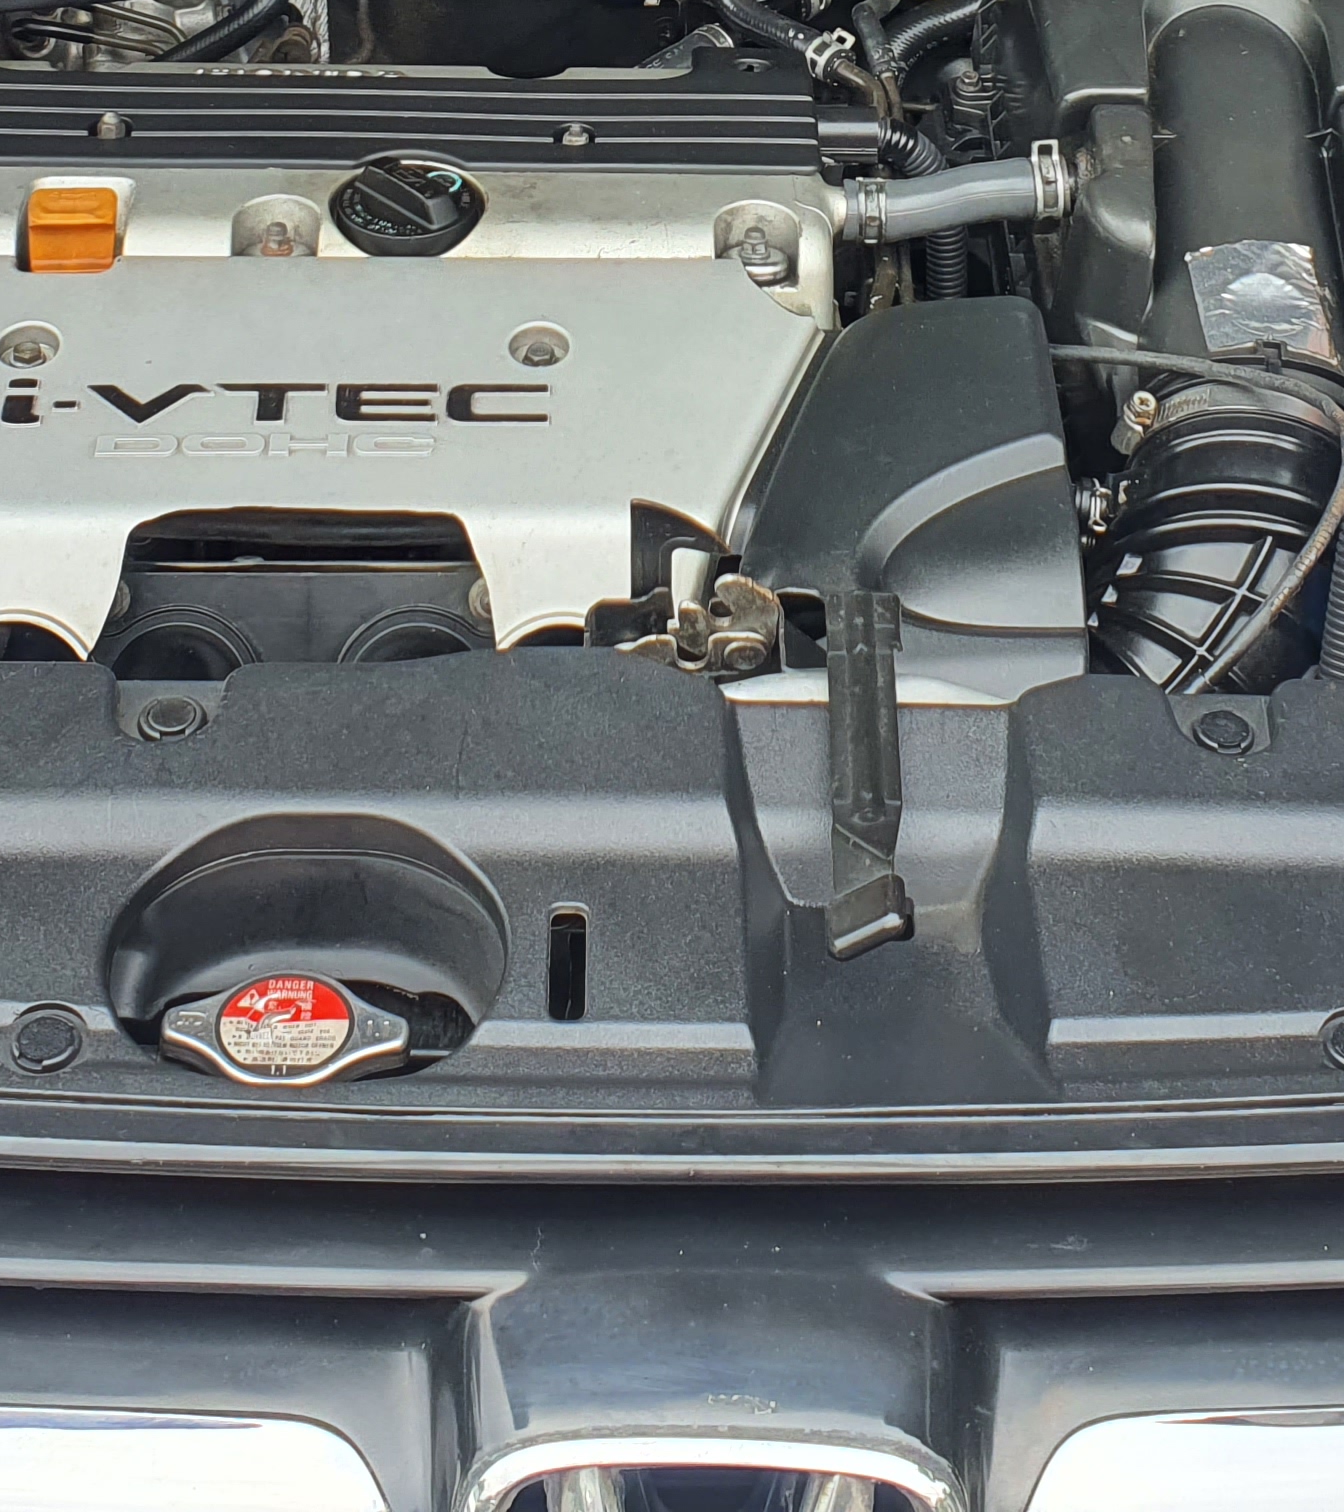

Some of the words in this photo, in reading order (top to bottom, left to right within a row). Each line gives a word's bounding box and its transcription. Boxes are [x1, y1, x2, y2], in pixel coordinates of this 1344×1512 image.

[0, 377, 551, 427] i-VTEC
[93, 432, 437, 458] DOHC
[268, 979, 314, 990] DANGER
[270, 1065, 287, 1076] 1.1
